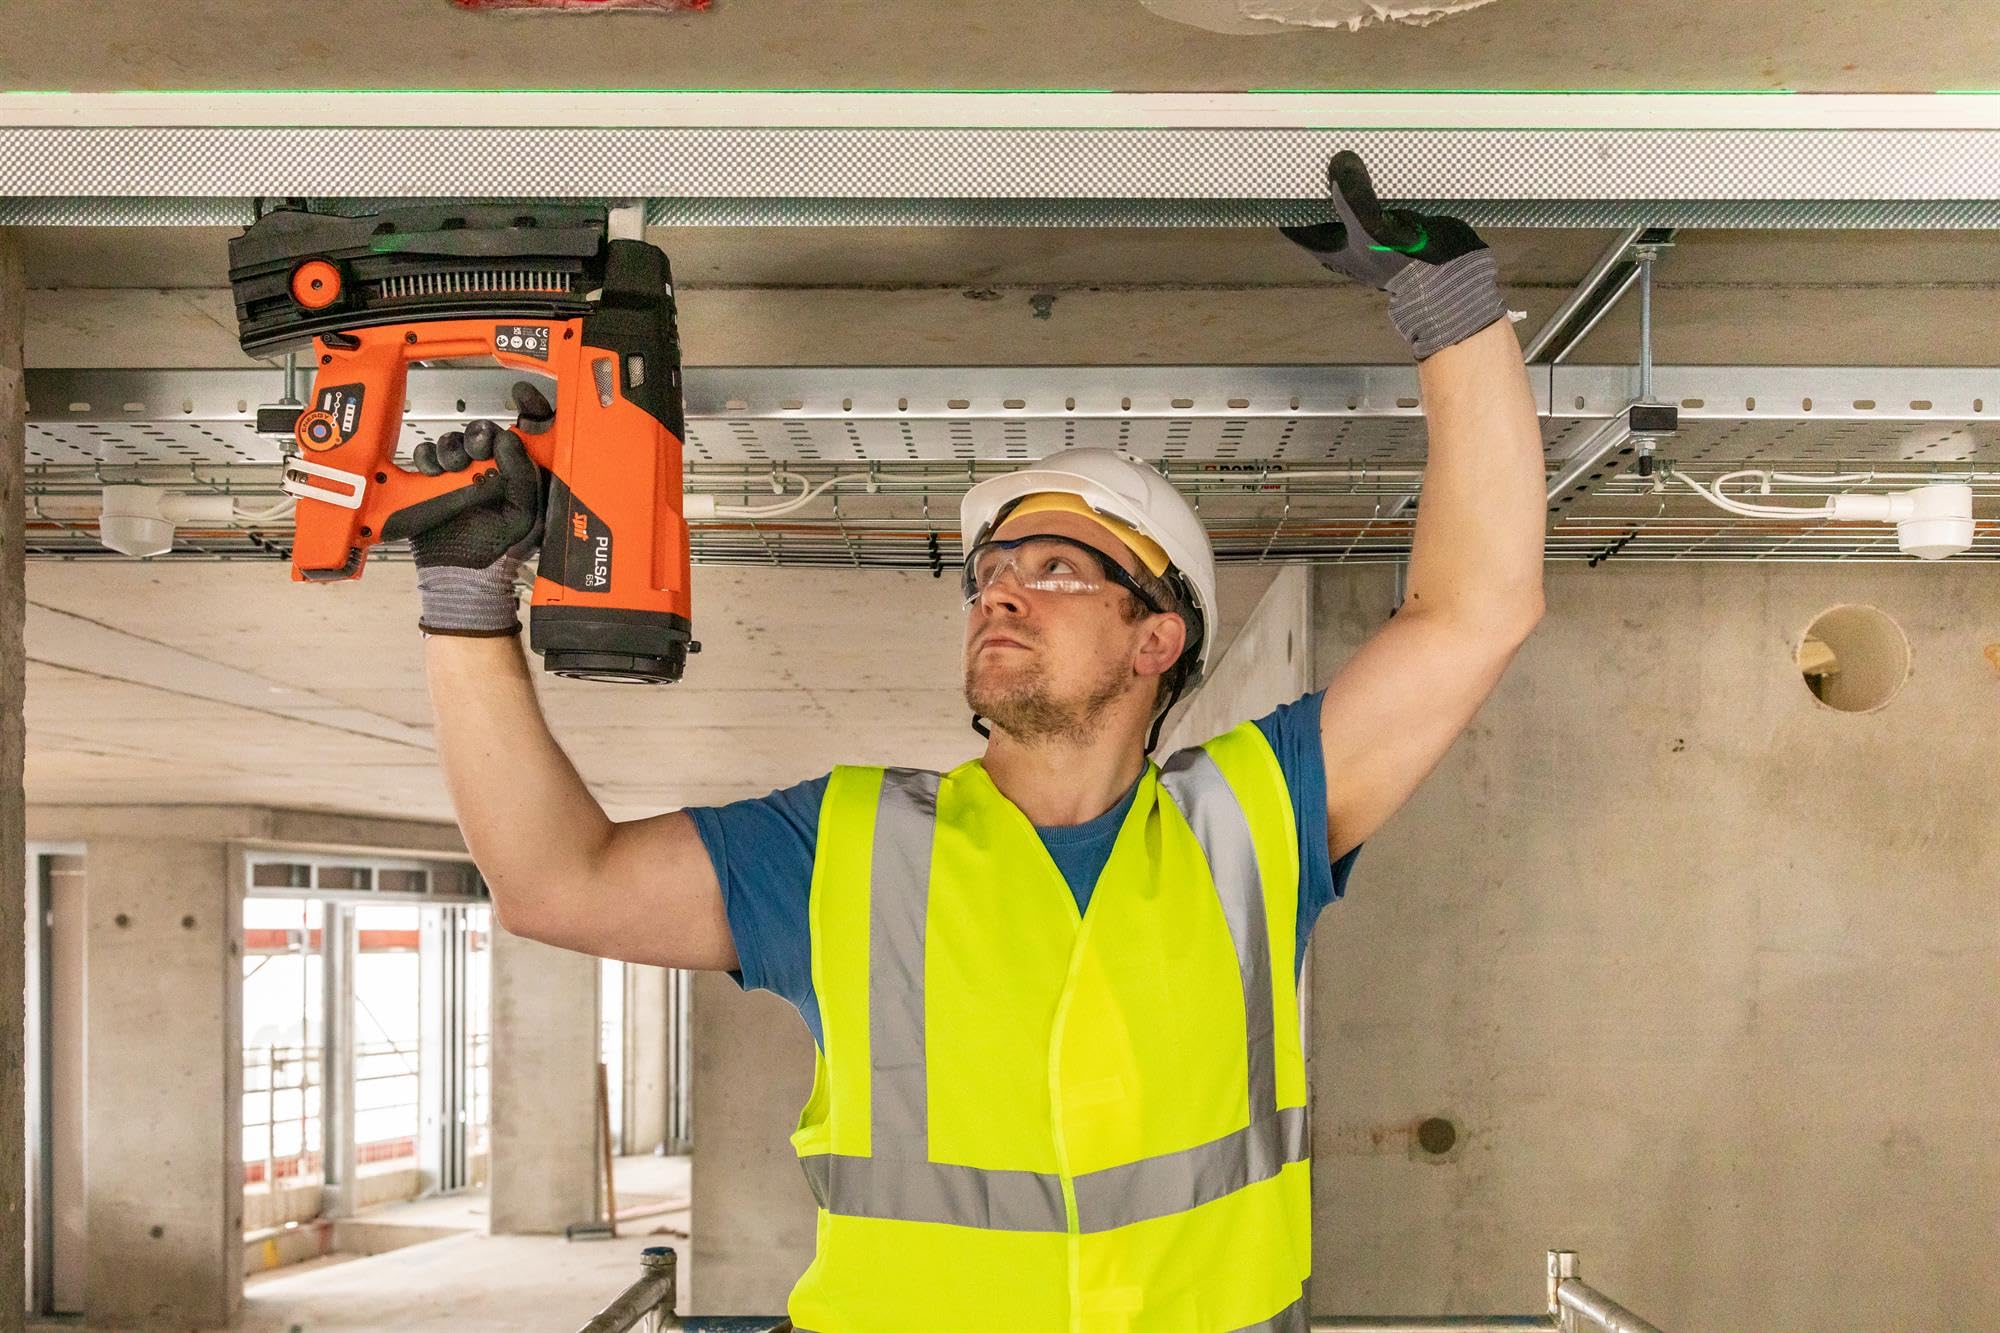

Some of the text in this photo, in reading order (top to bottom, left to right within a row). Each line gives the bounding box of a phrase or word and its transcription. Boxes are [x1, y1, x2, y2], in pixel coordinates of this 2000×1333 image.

[301, 412, 330, 433] ENERGY
[594, 536, 608, 586] PULSA
[585, 574, 594, 586] 65
